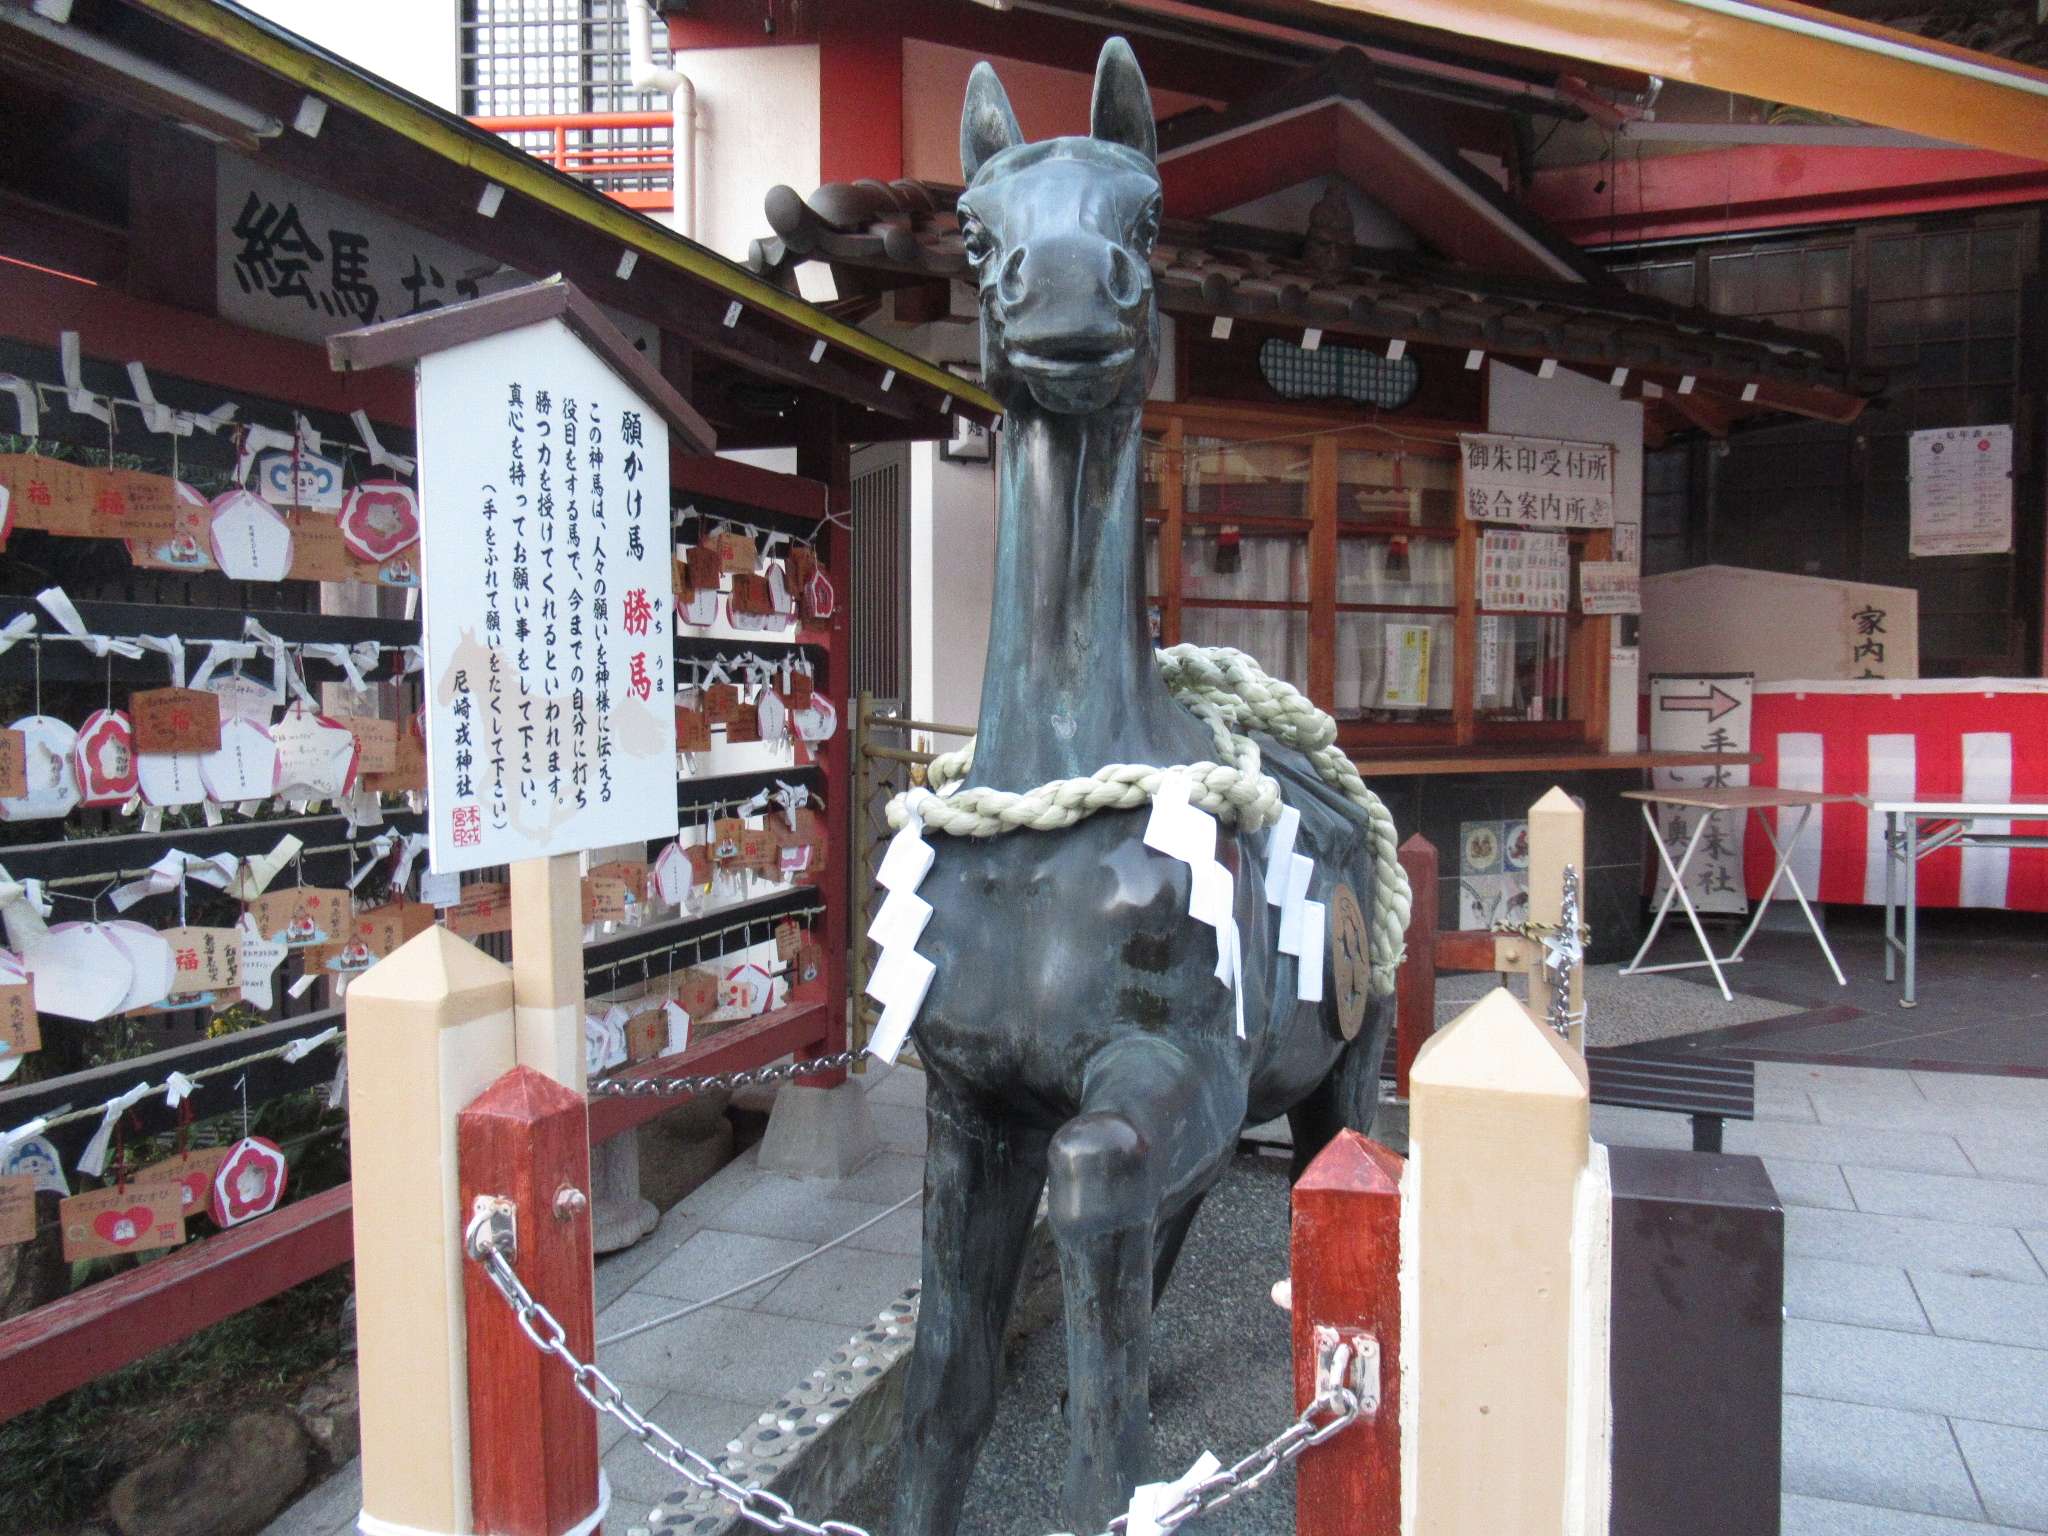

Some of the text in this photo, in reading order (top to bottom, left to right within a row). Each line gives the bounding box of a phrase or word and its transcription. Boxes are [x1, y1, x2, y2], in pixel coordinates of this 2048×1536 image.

[1467, 443, 1608, 481] 御朱印受付所
[1468, 490, 1585, 523] 総合案内所
[508, 382, 537, 806] 真心を持ってお願い事をして下さい。
[535, 390, 564, 805] 勝つ力を授けてくれるといわれます。
[562, 398, 588, 810] 役目をする馬で、今までの自分に打ち
[588, 402, 612, 803] この神馬は、人々の願いを神様に伝える
[621, 411, 652, 702] 願かけ馬 勝馬
[653, 597, 665, 693] かち うま
[1852, 604, 1887, 680] 家内
[452, 670, 475, 798] 尼崎戎神社
[176, 948, 198, 971] 福
